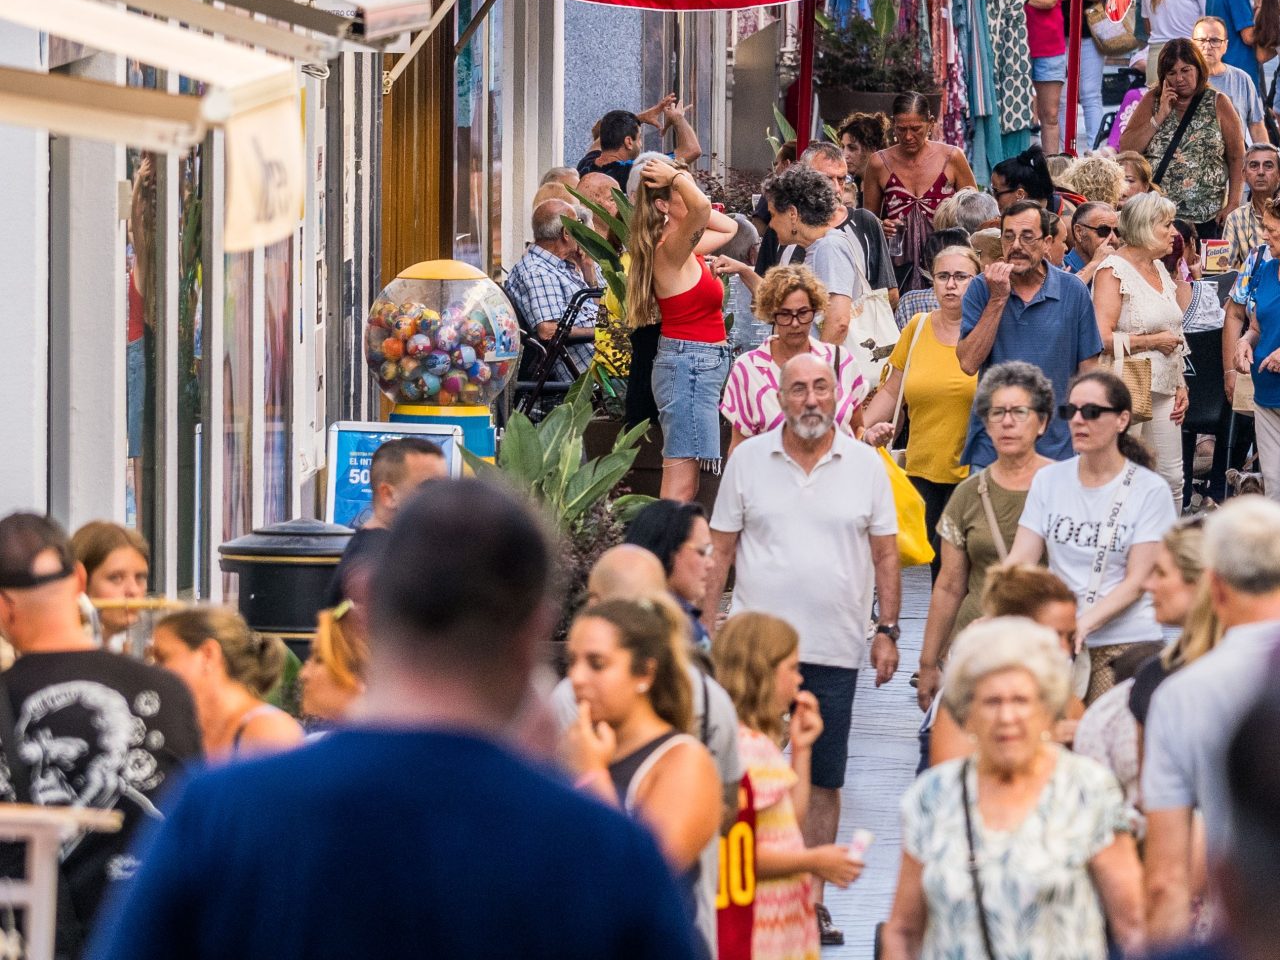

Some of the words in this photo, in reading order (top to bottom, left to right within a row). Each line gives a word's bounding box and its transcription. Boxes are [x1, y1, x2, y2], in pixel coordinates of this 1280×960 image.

[348, 468, 371, 485] 50
[1107, 501, 1122, 528] TOUS
[1093, 544, 1107, 574] TOUS
